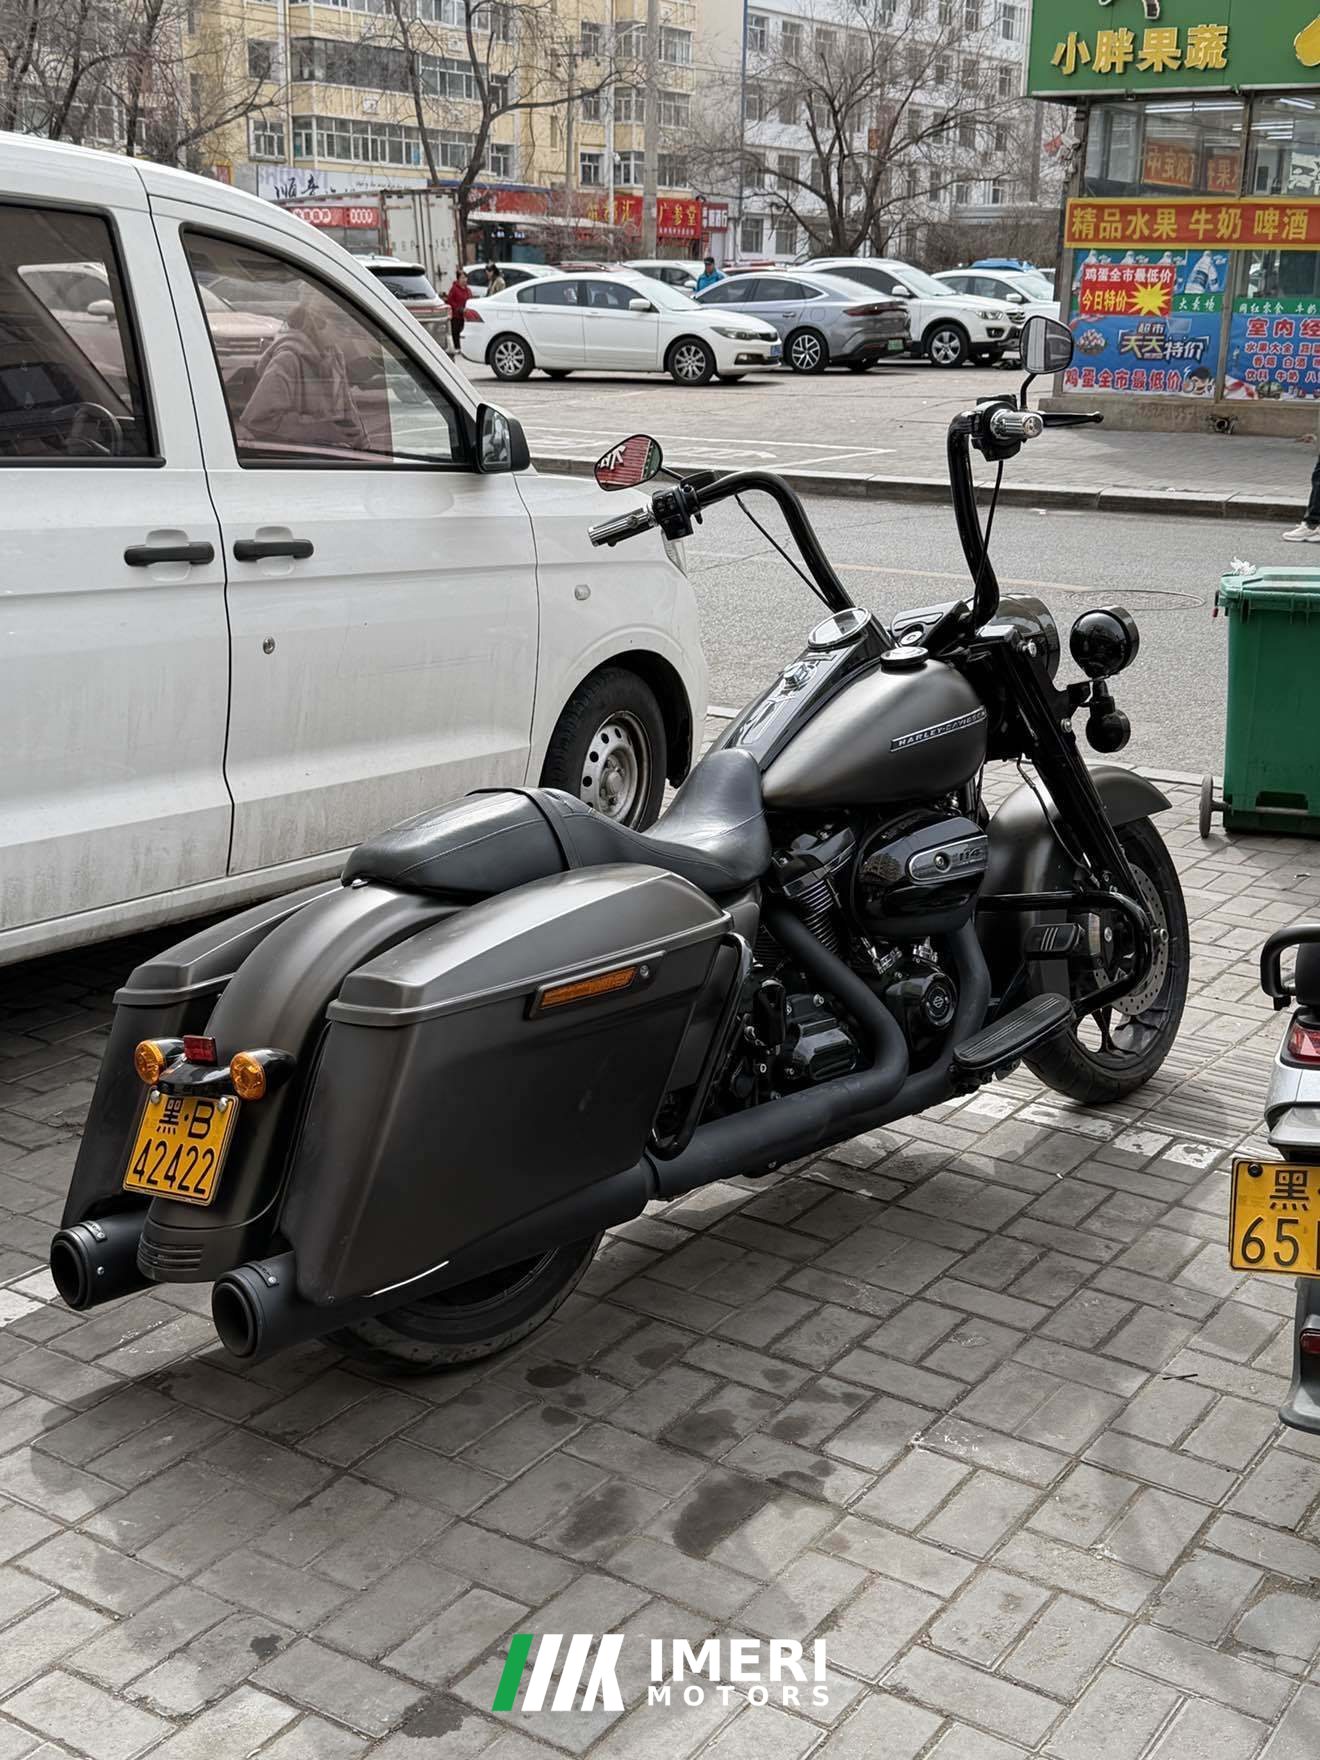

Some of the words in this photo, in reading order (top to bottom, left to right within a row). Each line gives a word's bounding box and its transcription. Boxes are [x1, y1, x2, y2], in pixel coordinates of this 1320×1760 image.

[1051, 24, 1229, 75] 小胖果蔬
[1072, 208, 1178, 241] 精品水果
[1189, 208, 1242, 241] 牛奶
[1254, 208, 1309, 241] 啤酒
[1085, 267, 1172, 284] 鸡蛋全市最低价
[1082, 288, 1127, 311] 今日特价
[1121, 335, 1204, 360] 天天特价
[1064, 367, 1182, 391] 鸡蛋全市最低价
[133, 1138, 215, 1195] 42422
[1241, 1217, 1320, 1269] 65
